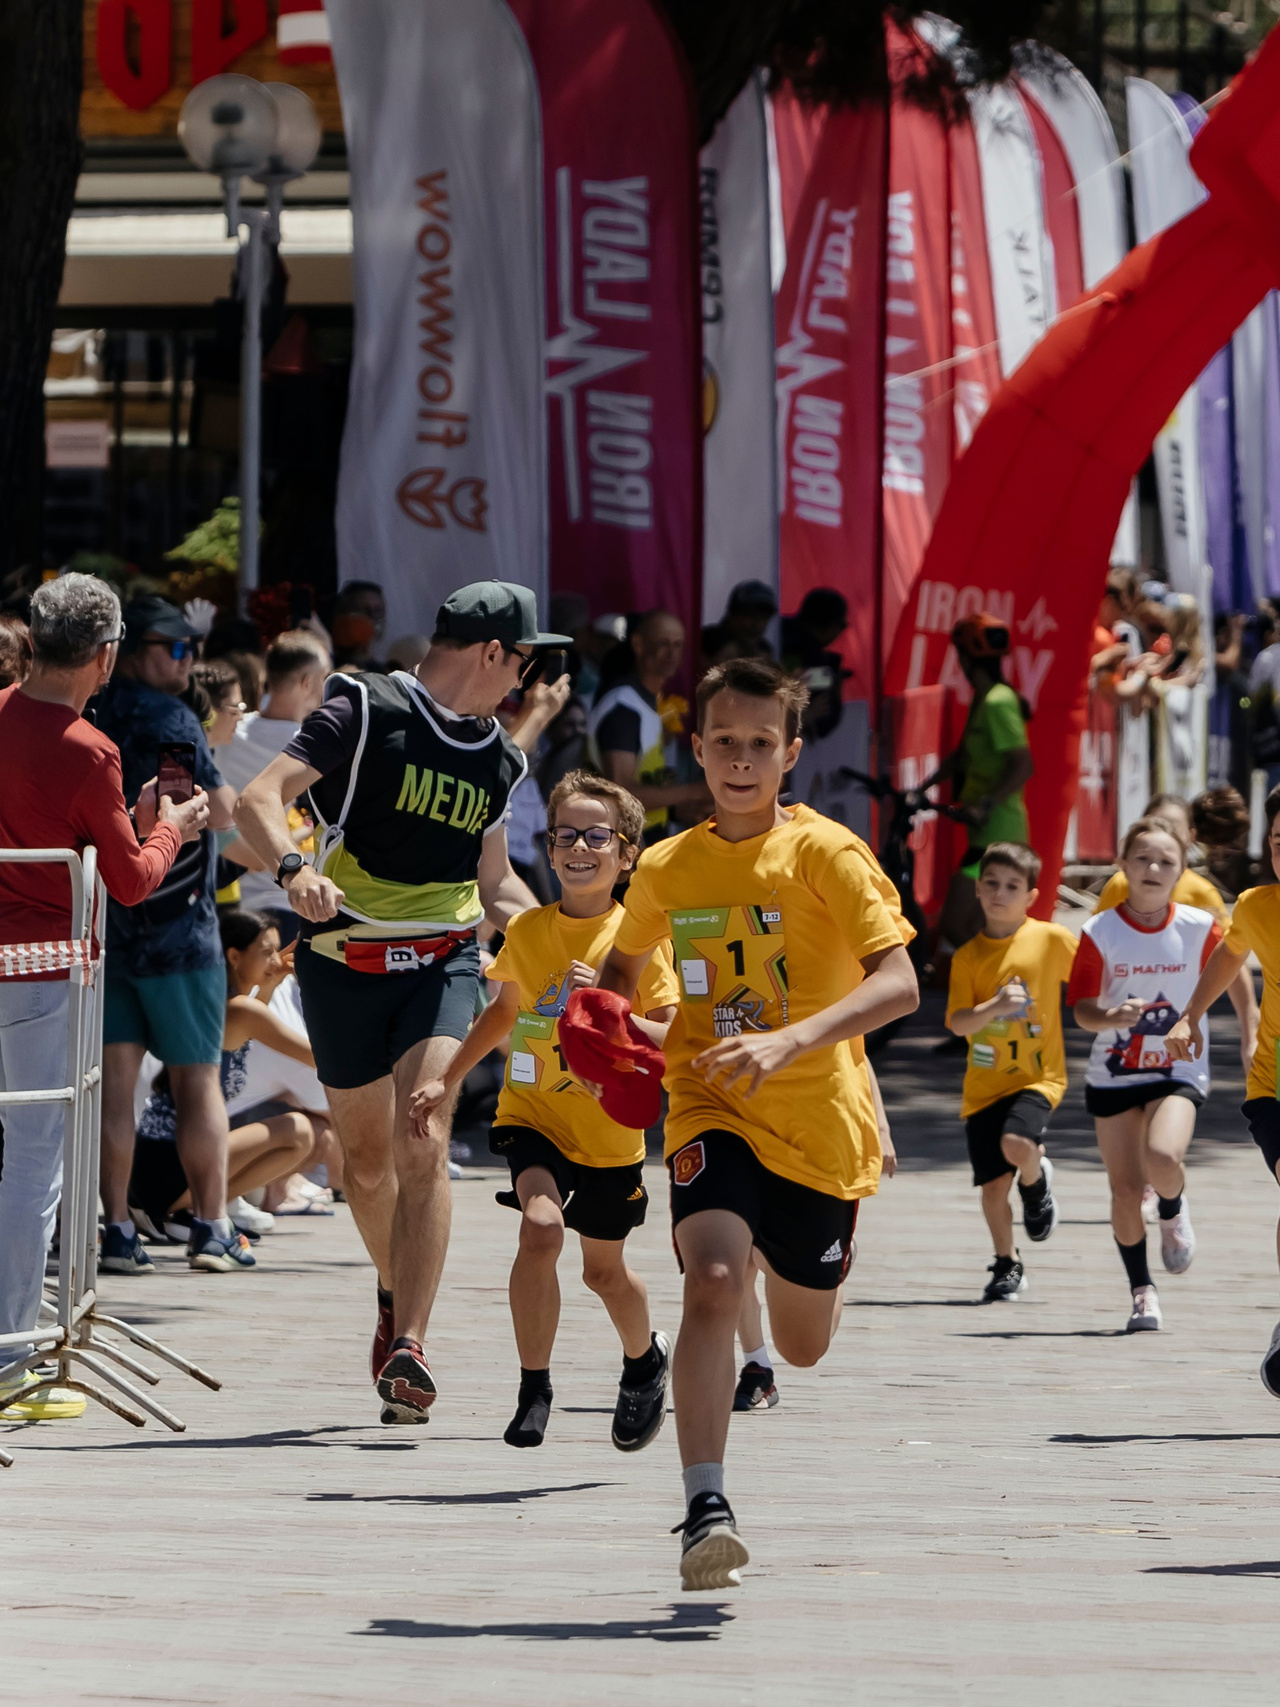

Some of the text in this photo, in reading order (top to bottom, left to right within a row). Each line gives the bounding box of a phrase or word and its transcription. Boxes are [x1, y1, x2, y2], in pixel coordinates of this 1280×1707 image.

[914, 579, 1015, 632] IRON
[906, 635, 1055, 712] LAY
[764, 913, 779, 921] 7-12
[726, 940, 745, 976] 1
[1133, 963, 1187, 975] МАГНИТ
[713, 1007, 735, 1020] STAR
[714, 1020, 742, 1038] KIDS
[1008, 1040, 1018, 1060] 1
